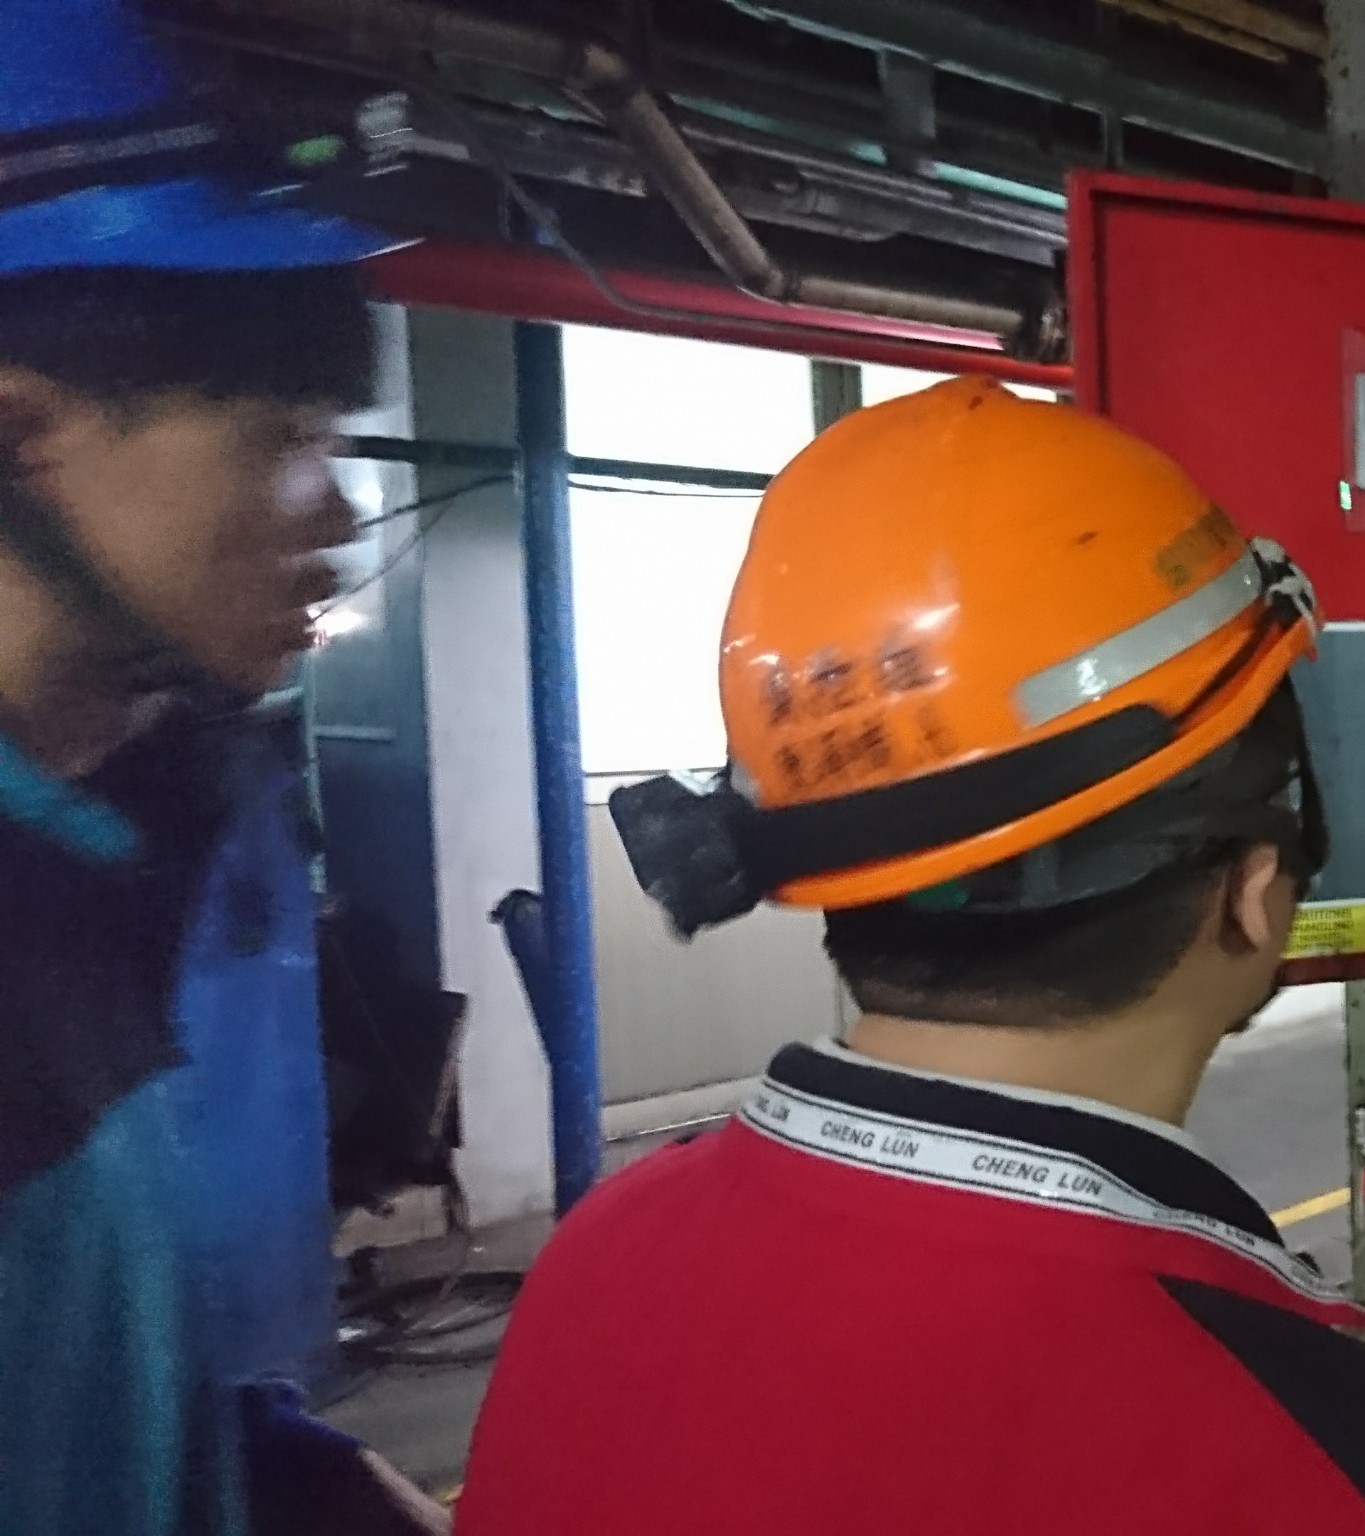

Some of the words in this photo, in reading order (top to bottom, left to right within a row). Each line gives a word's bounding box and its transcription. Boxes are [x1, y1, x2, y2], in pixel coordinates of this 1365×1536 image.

[821, 1120, 874, 1148] CHENG
[880, 1136, 920, 1159] LUN
[972, 1154, 1050, 1185] CHENG
[1057, 1172, 1102, 1197] LUN
